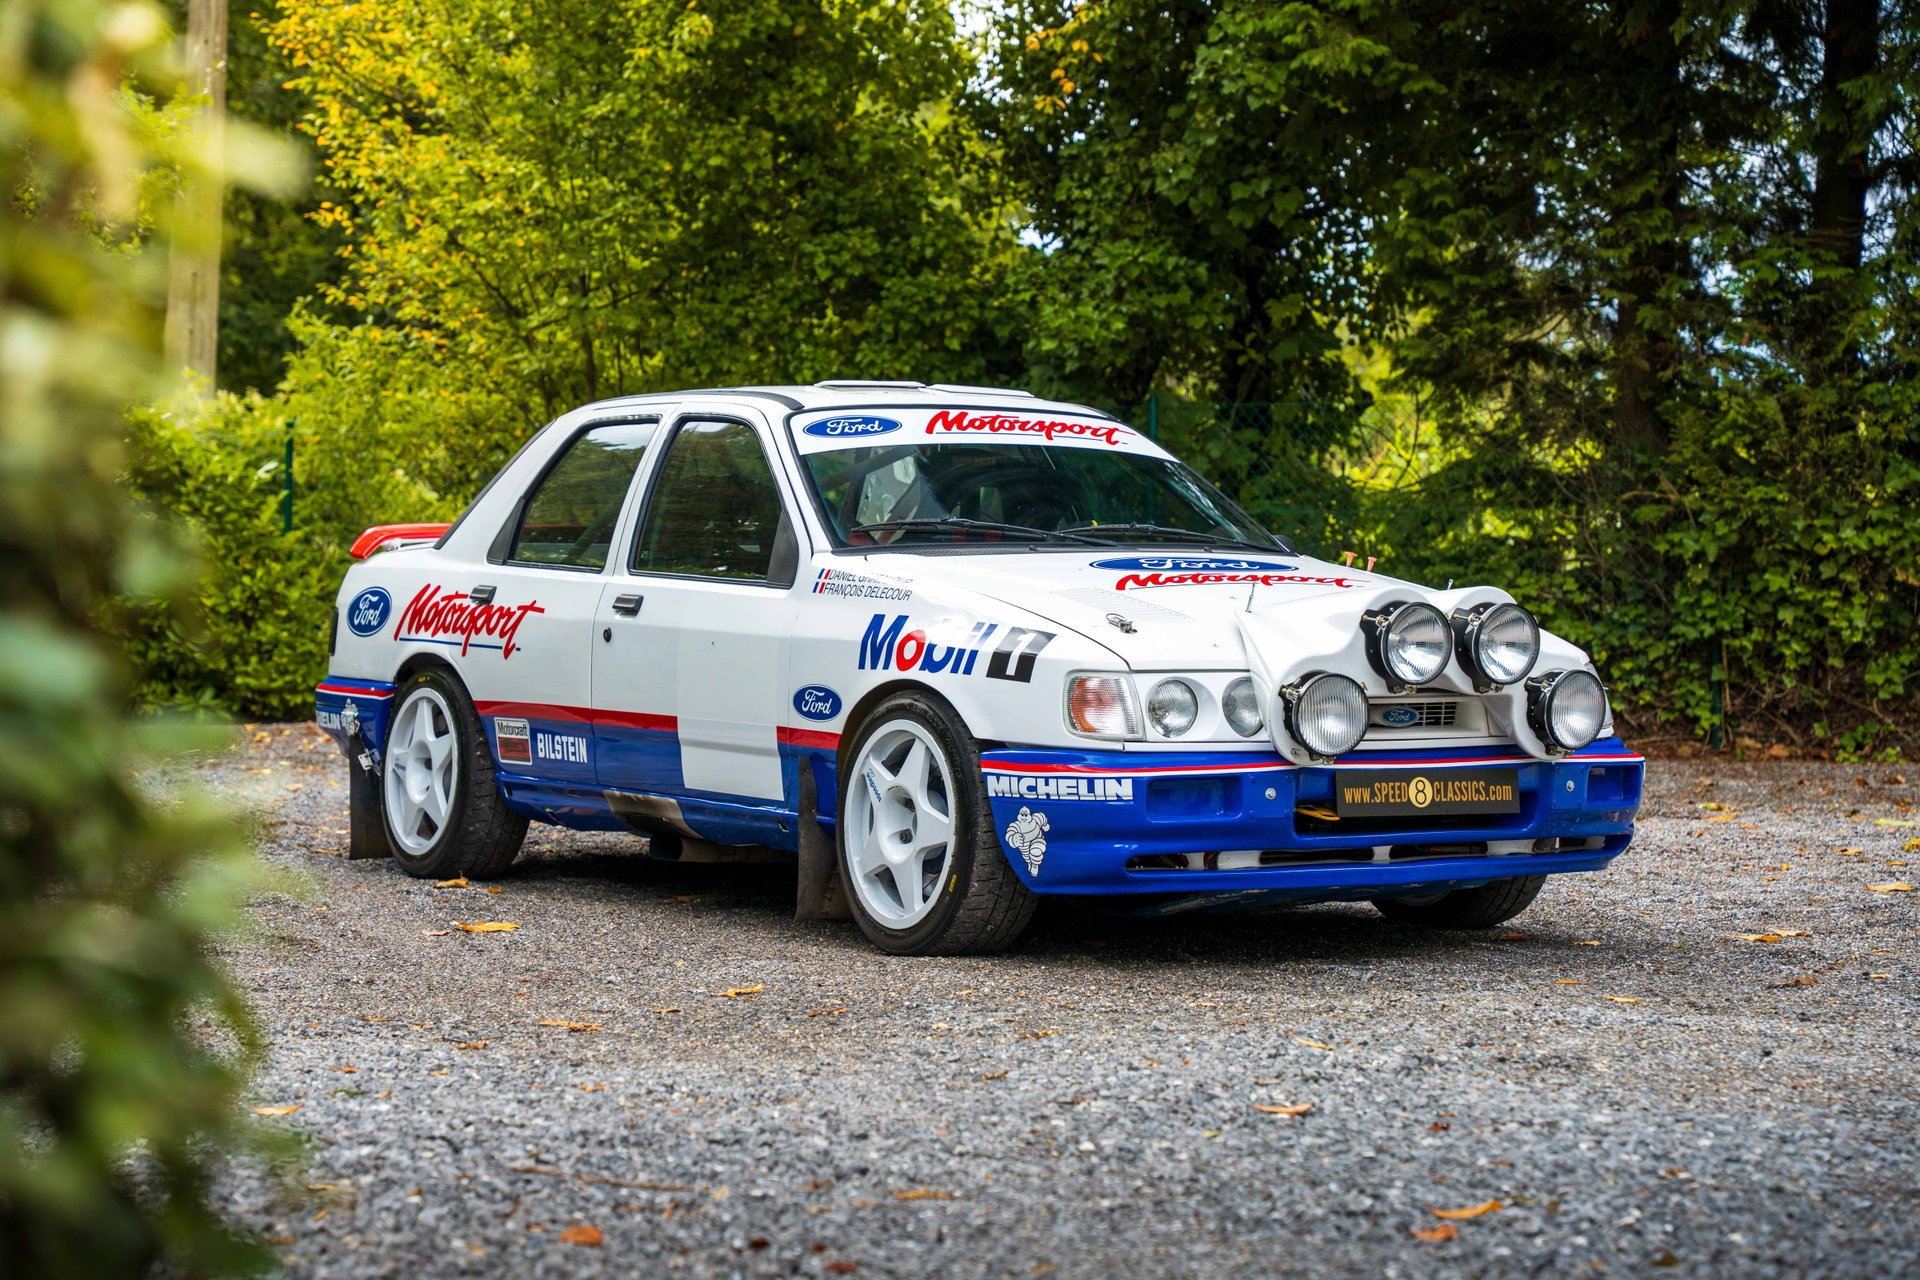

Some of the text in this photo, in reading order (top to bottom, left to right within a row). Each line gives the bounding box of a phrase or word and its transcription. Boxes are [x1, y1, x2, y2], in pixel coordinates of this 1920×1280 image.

[826, 417, 884, 435] Ford
[924, 410, 1136, 446] Motorsport
[1139, 558, 1260, 570] Ford
[828, 569, 857, 582] DANIEL
[1115, 572, 1371, 590] Motorsport
[823, 582, 913, 601] FRANÇOIS DELECOUR
[354, 593, 383, 627] Ford
[394, 583, 545, 660] Motorsport
[858, 613, 998, 676] Mobil
[801, 689, 833, 715] Ford
[1388, 707, 1411, 722] Ford
[497, 721, 528, 737] Motorcraft
[536, 732, 588, 763] BILSTEIN
[986, 775, 1134, 801] MICHELIN
